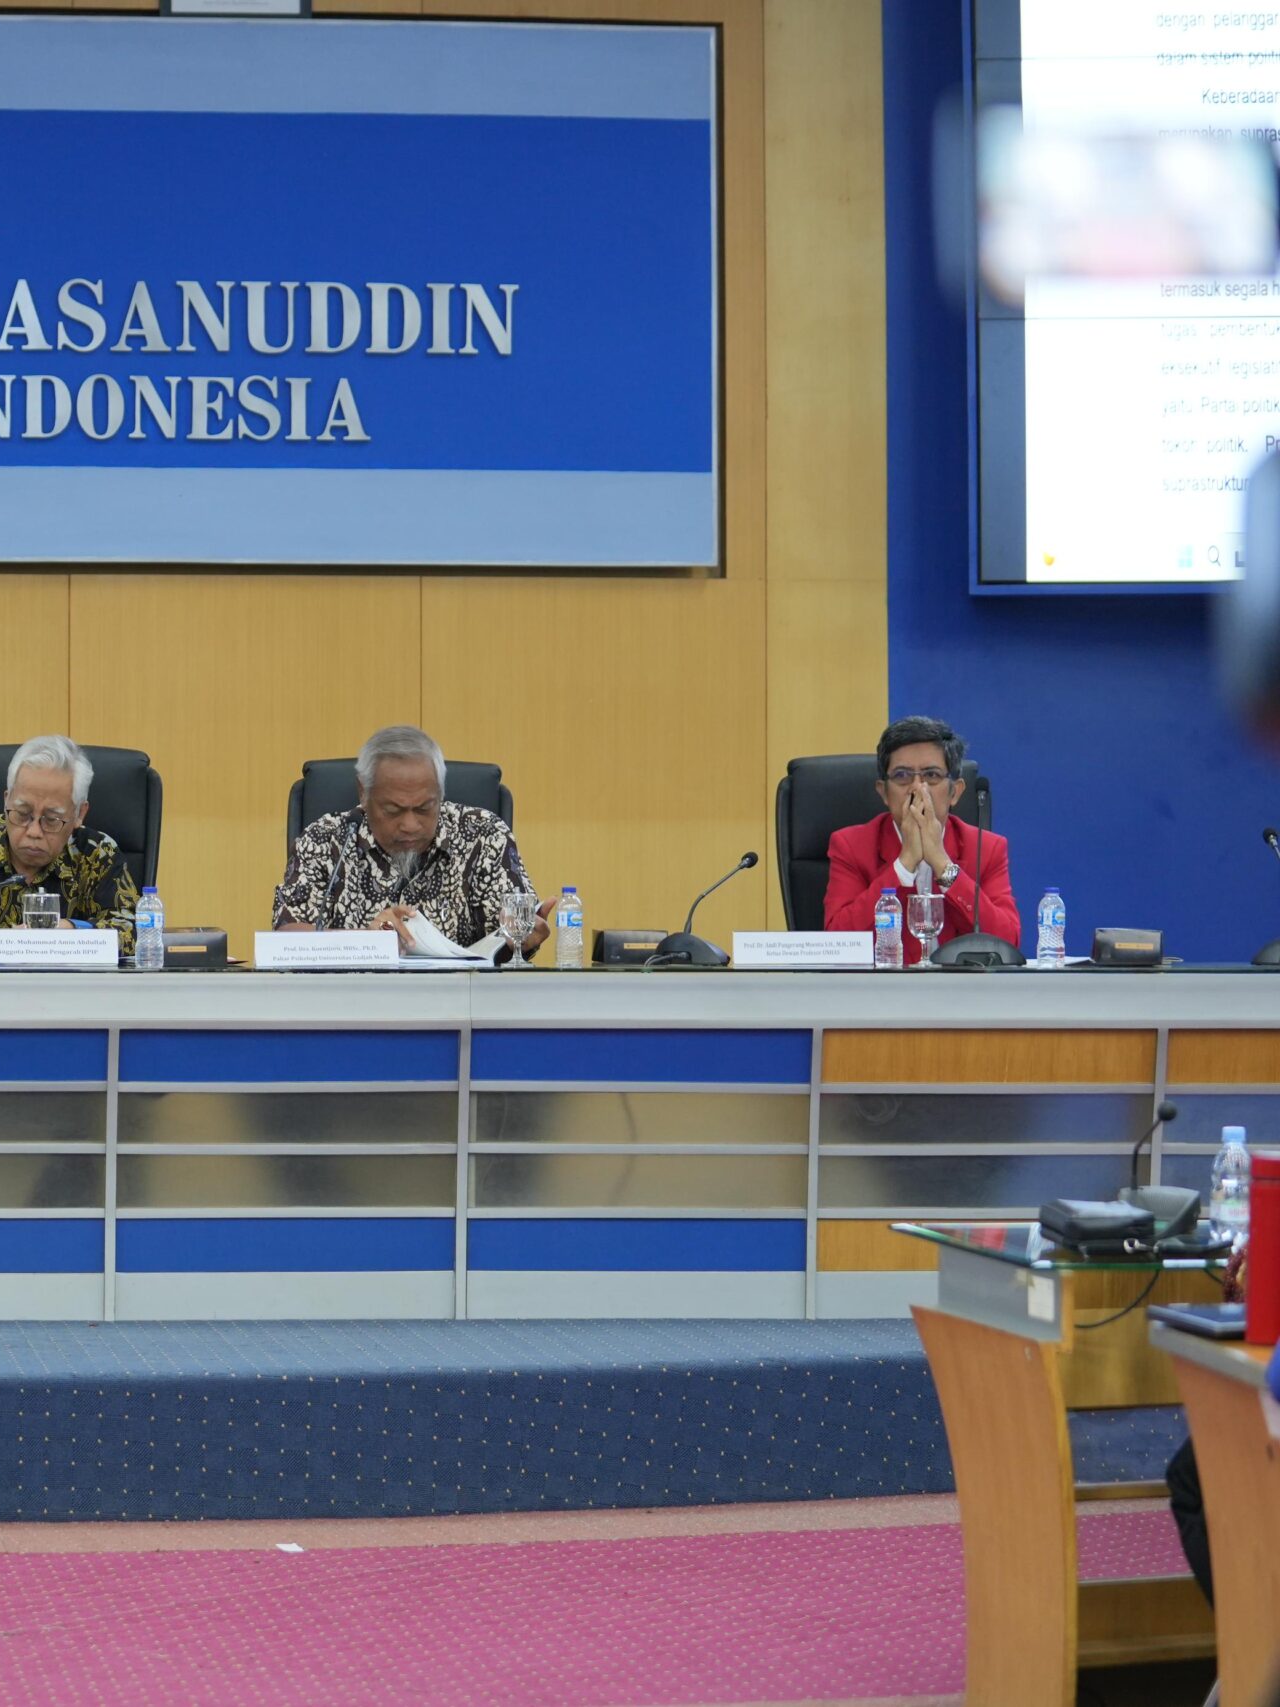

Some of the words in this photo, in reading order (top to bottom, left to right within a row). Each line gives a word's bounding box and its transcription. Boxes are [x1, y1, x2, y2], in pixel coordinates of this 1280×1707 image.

[1157, 11, 1206, 32] dengan
[1160, 280, 1221, 298] termasuk
[1224, 280, 1268, 302] segala
